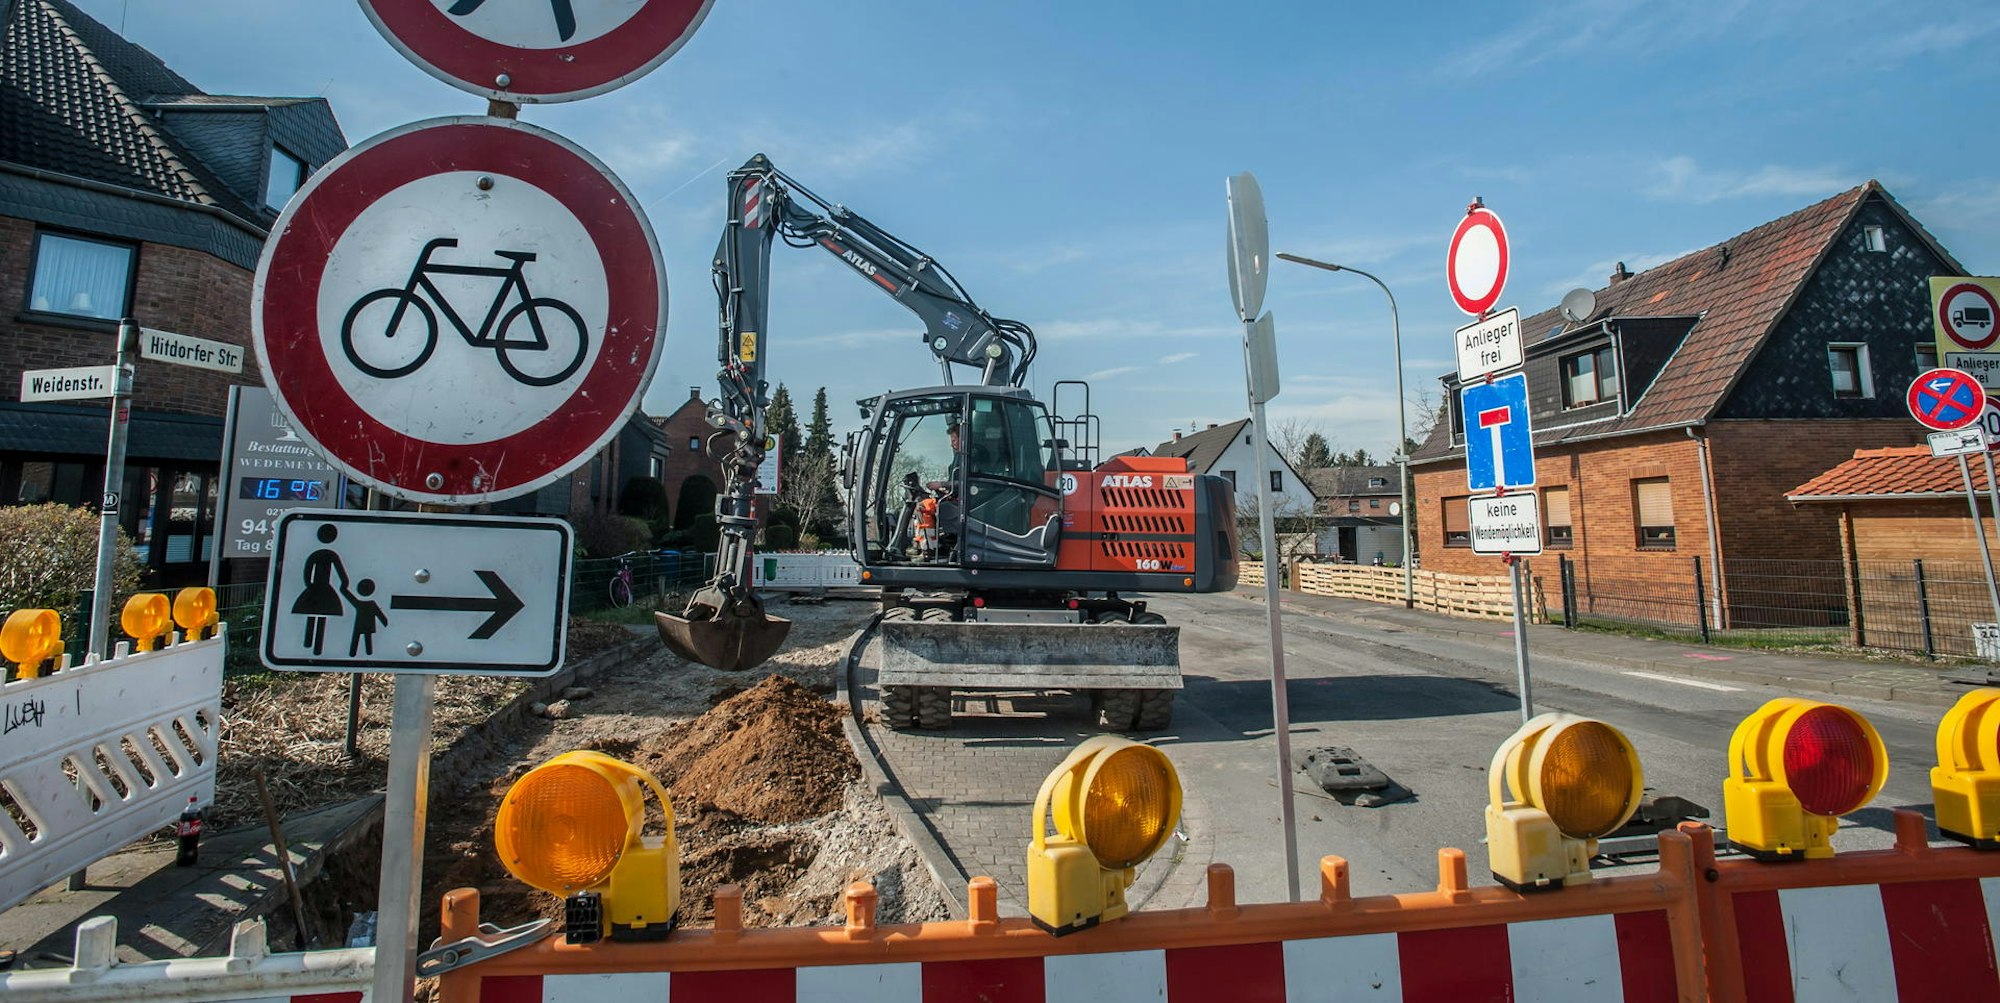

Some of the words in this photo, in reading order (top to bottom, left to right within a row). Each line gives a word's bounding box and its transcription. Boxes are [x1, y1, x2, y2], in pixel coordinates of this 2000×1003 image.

[842, 249, 877, 275] ATLAS
[1465, 321, 1513, 351] Anlieger
[151, 336, 214, 363] Hitdorfer
[218, 351, 237, 367] Str.
[1480, 346, 1501, 369] frei
[1956, 356, 2000, 371] Anlieger
[32, 376, 103, 394] Weidenstr.
[257, 479, 280, 499] 16
[1102, 475, 1152, 488] ATLAS
[1486, 503, 1517, 518] keine
[1475, 523, 1536, 541] Wendemöglichkeit
[235, 539, 260, 552] Tag
